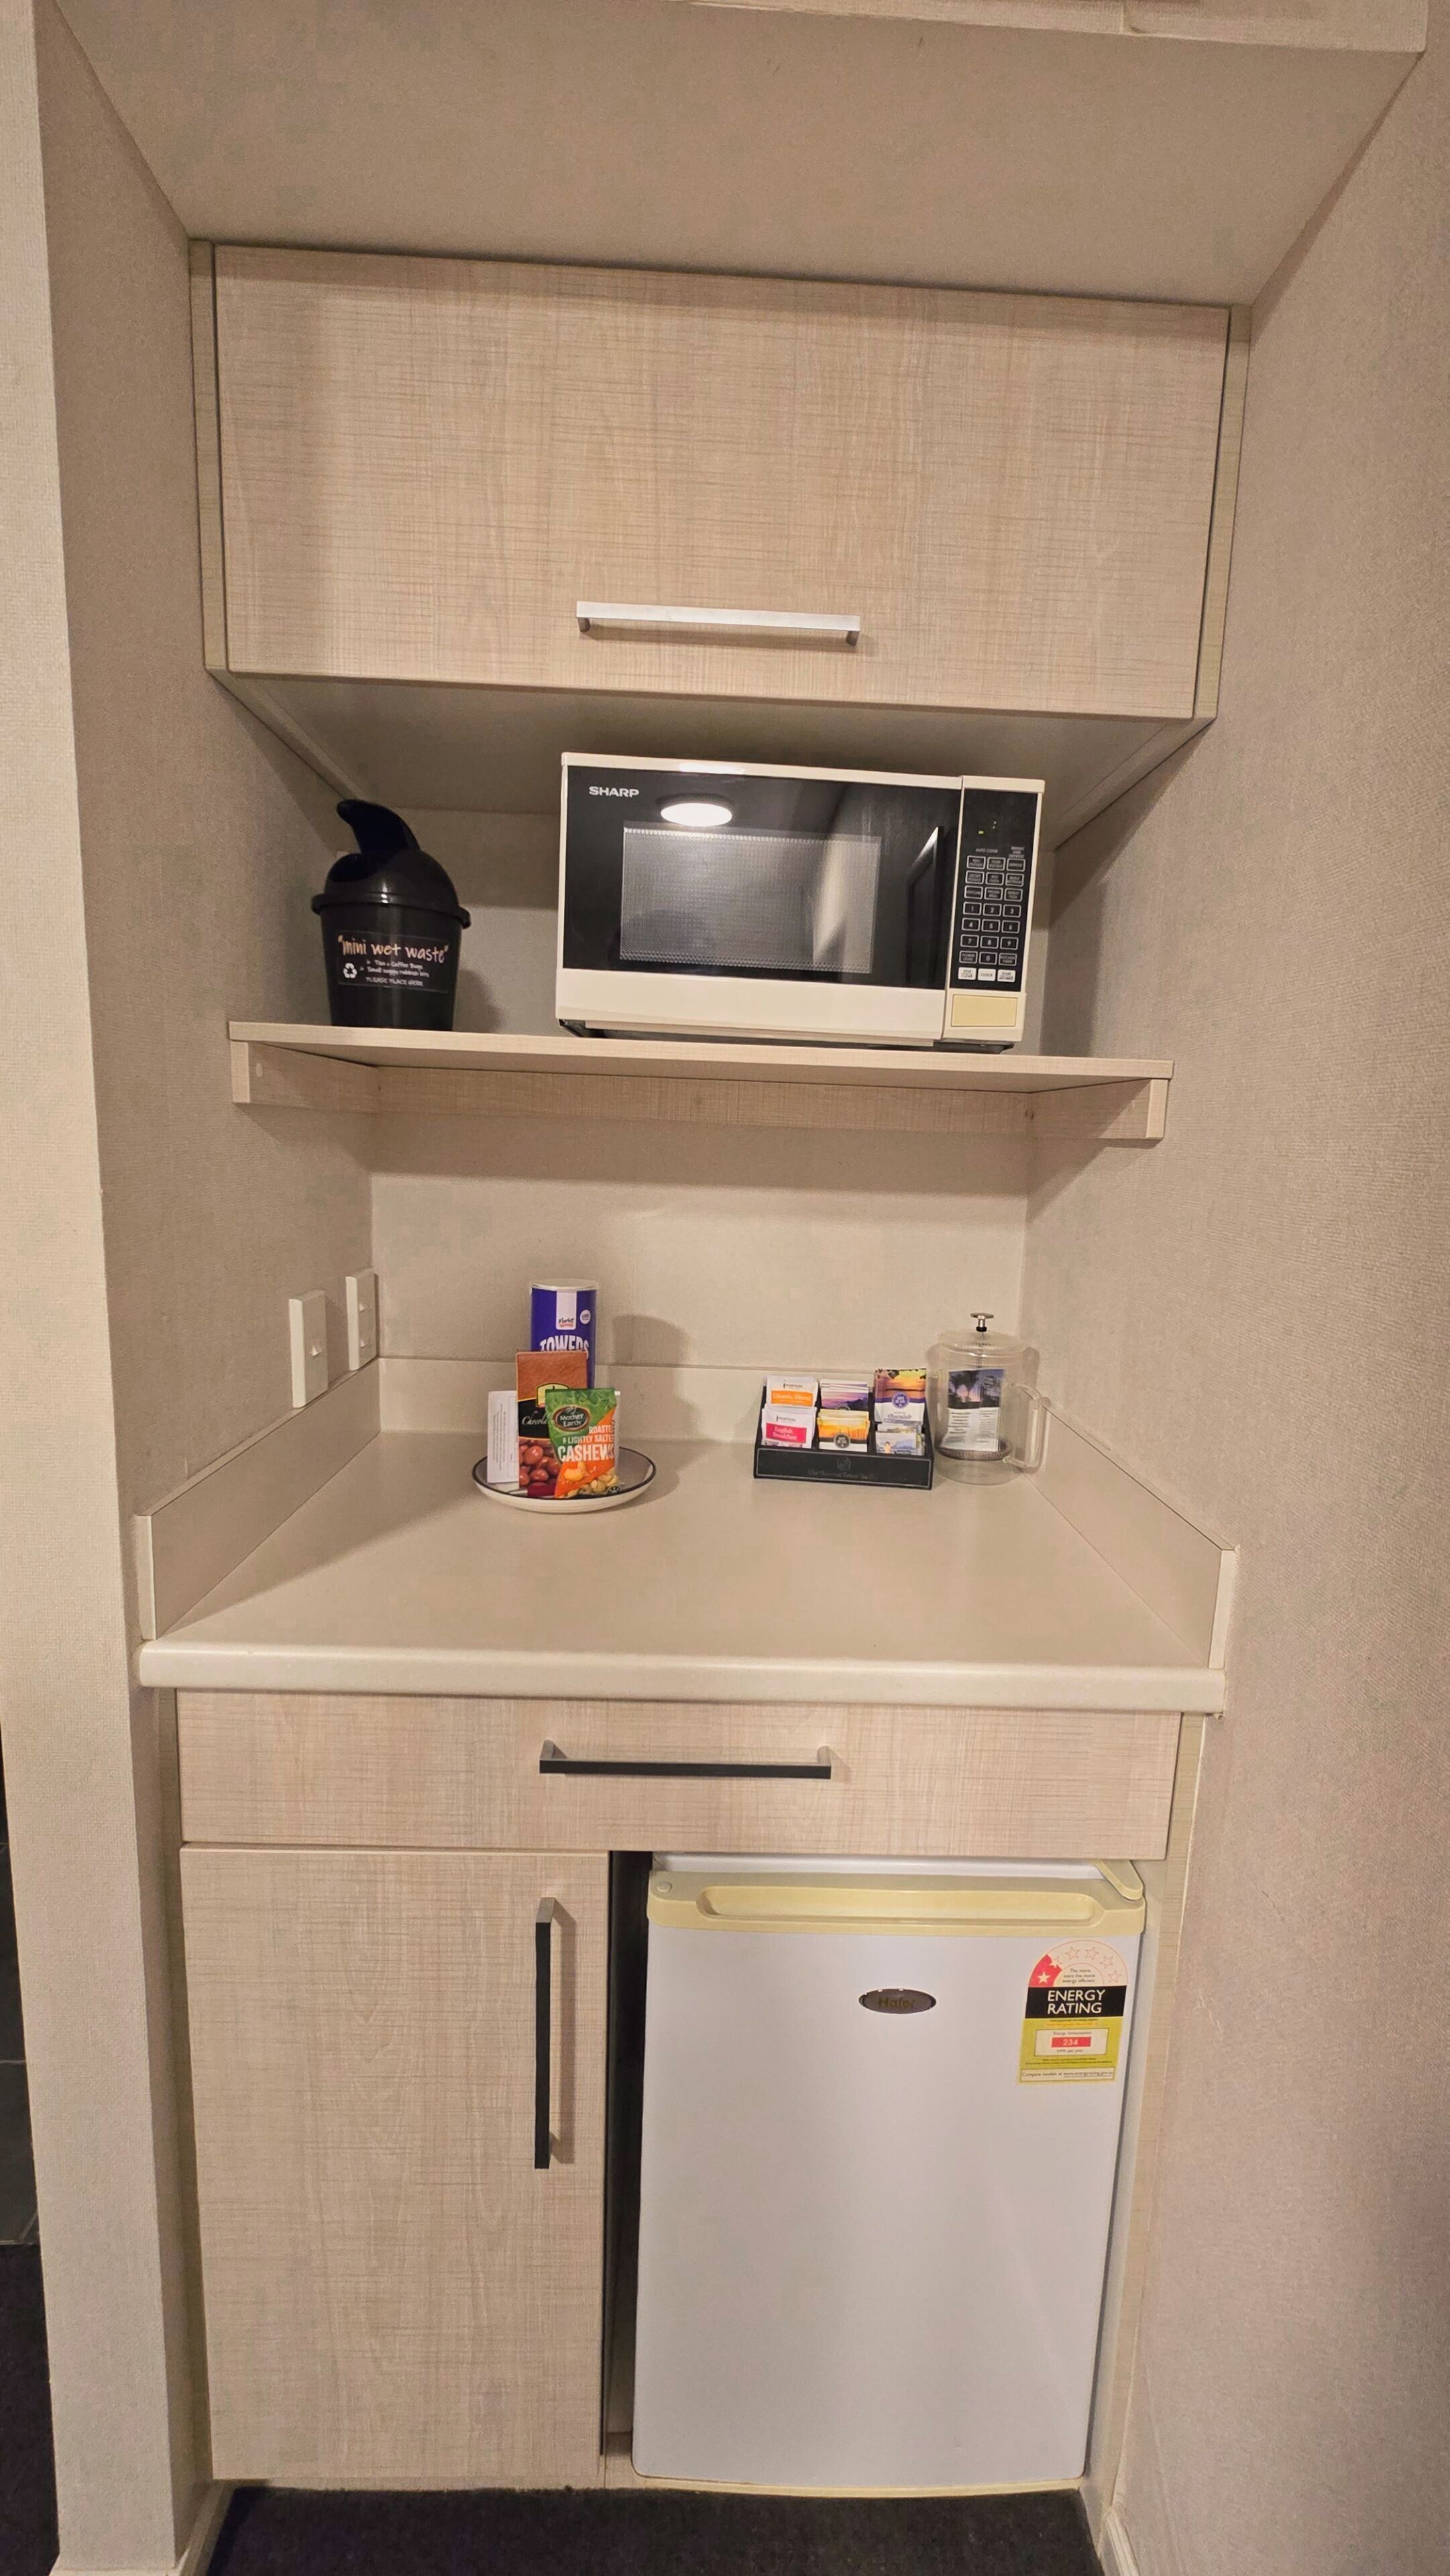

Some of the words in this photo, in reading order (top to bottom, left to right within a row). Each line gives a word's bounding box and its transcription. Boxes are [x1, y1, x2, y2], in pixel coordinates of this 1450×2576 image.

[589, 786, 640, 798] SHARP
[370, 943, 402, 957] wet
[366, 976, 388, 984] PLEASE
[589, 1424, 614, 1434] ROASTE
[774, 1426, 793, 1434] English
[567, 1435, 594, 1444] LIGHTLY
[594, 1434, 615, 1443] SALTE
[1047, 1988, 1106, 2002] ENERGY
[1047, 2002, 1102, 2015] RATING
